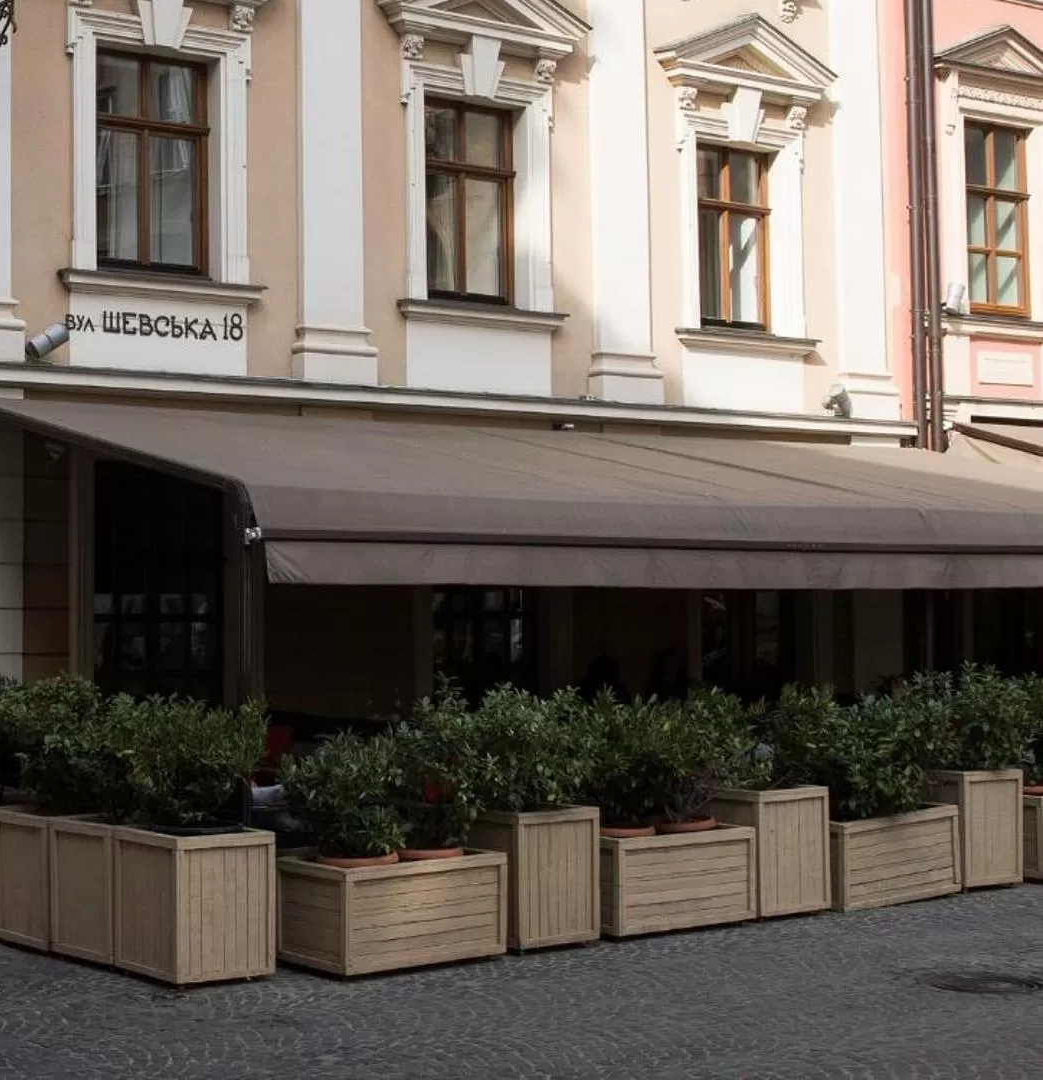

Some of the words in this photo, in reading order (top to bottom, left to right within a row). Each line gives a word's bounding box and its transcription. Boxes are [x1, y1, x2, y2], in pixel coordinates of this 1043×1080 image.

[65, 314, 94, 332] ВУЛ
[102, 310, 217, 341] ШЕВСЬКА
[223, 313, 244, 341] 18
